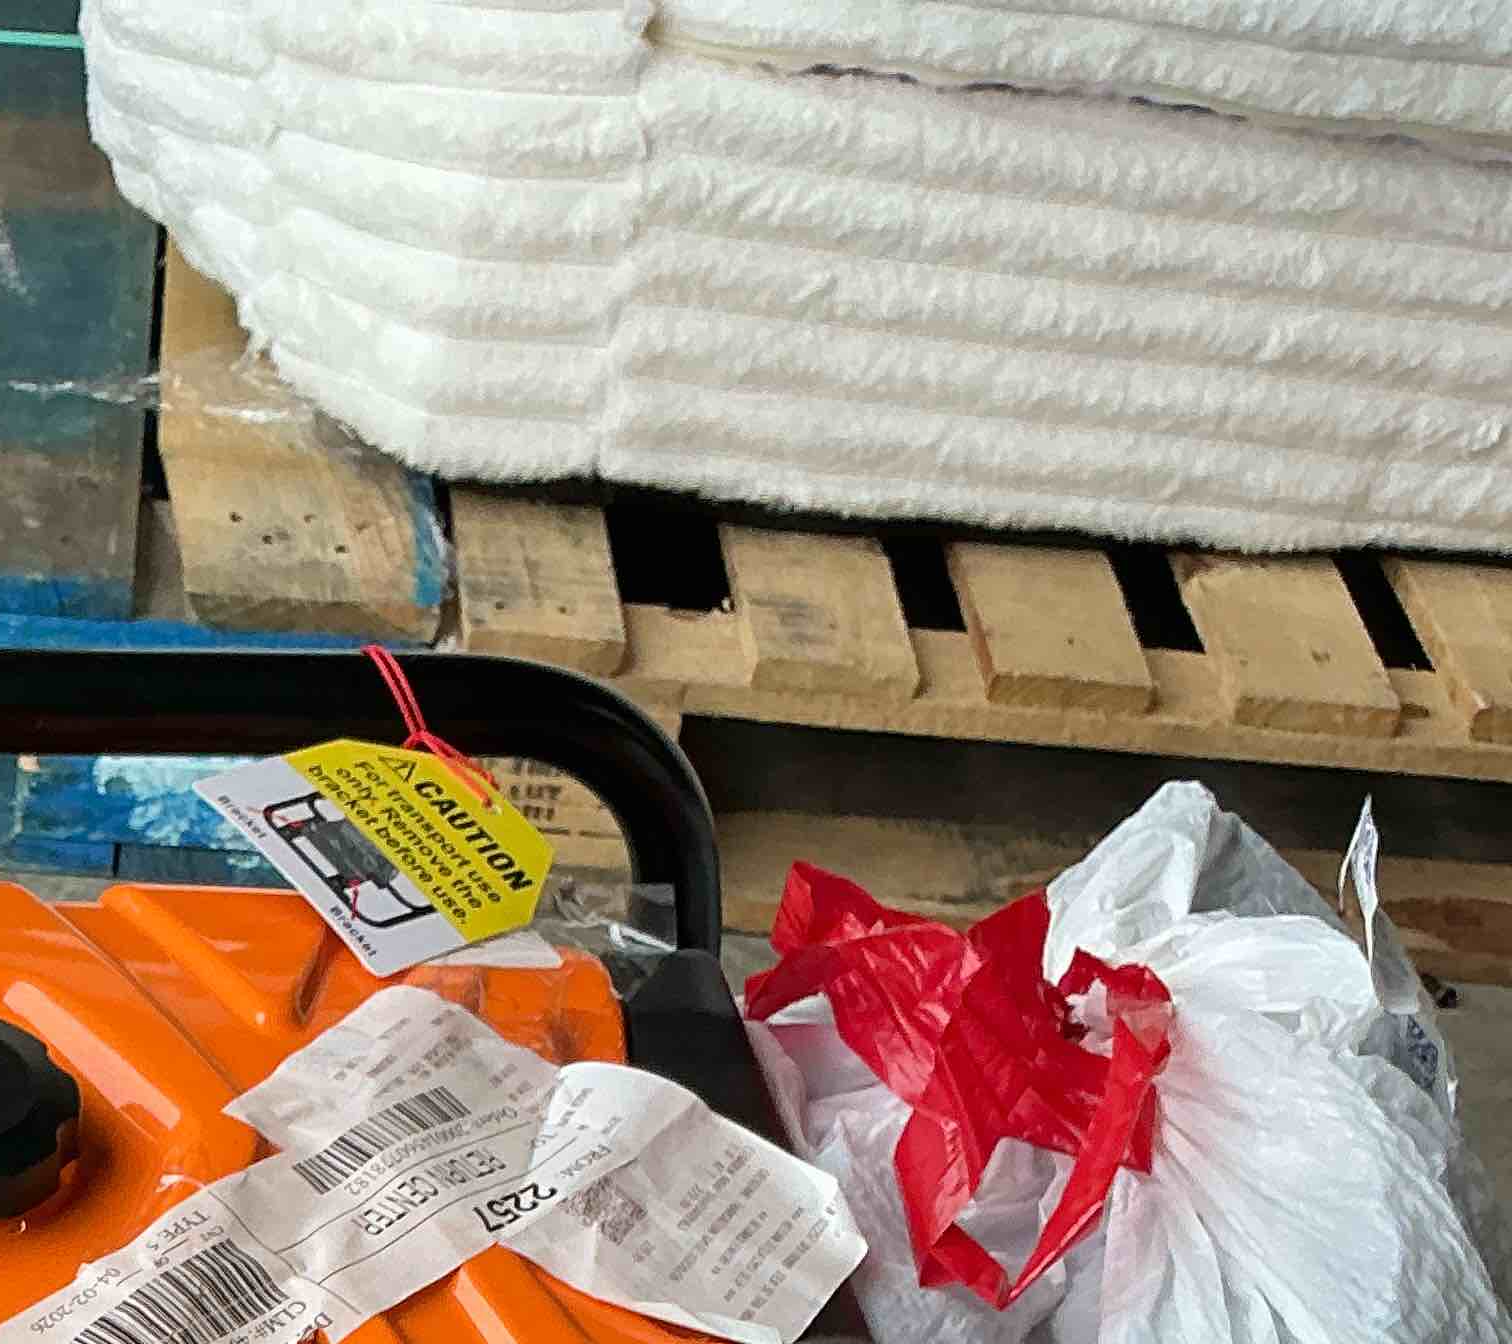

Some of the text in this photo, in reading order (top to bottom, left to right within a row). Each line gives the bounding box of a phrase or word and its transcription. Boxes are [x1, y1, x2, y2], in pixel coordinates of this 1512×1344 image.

[309, 765, 378, 825] bracket
[375, 827, 432, 882] before
[354, 761, 501, 902] For transport use
[379, 808, 452, 877] Remove
[452, 880, 481, 908] the
[414, 780, 533, 890] CAUTION
[330, 906, 377, 957] Bracket
[351, 1149, 507, 1236] RETURN CENTER
[473, 1183, 558, 1233] 2257
[30, 1267, 121, 1335] 04-02-2026
